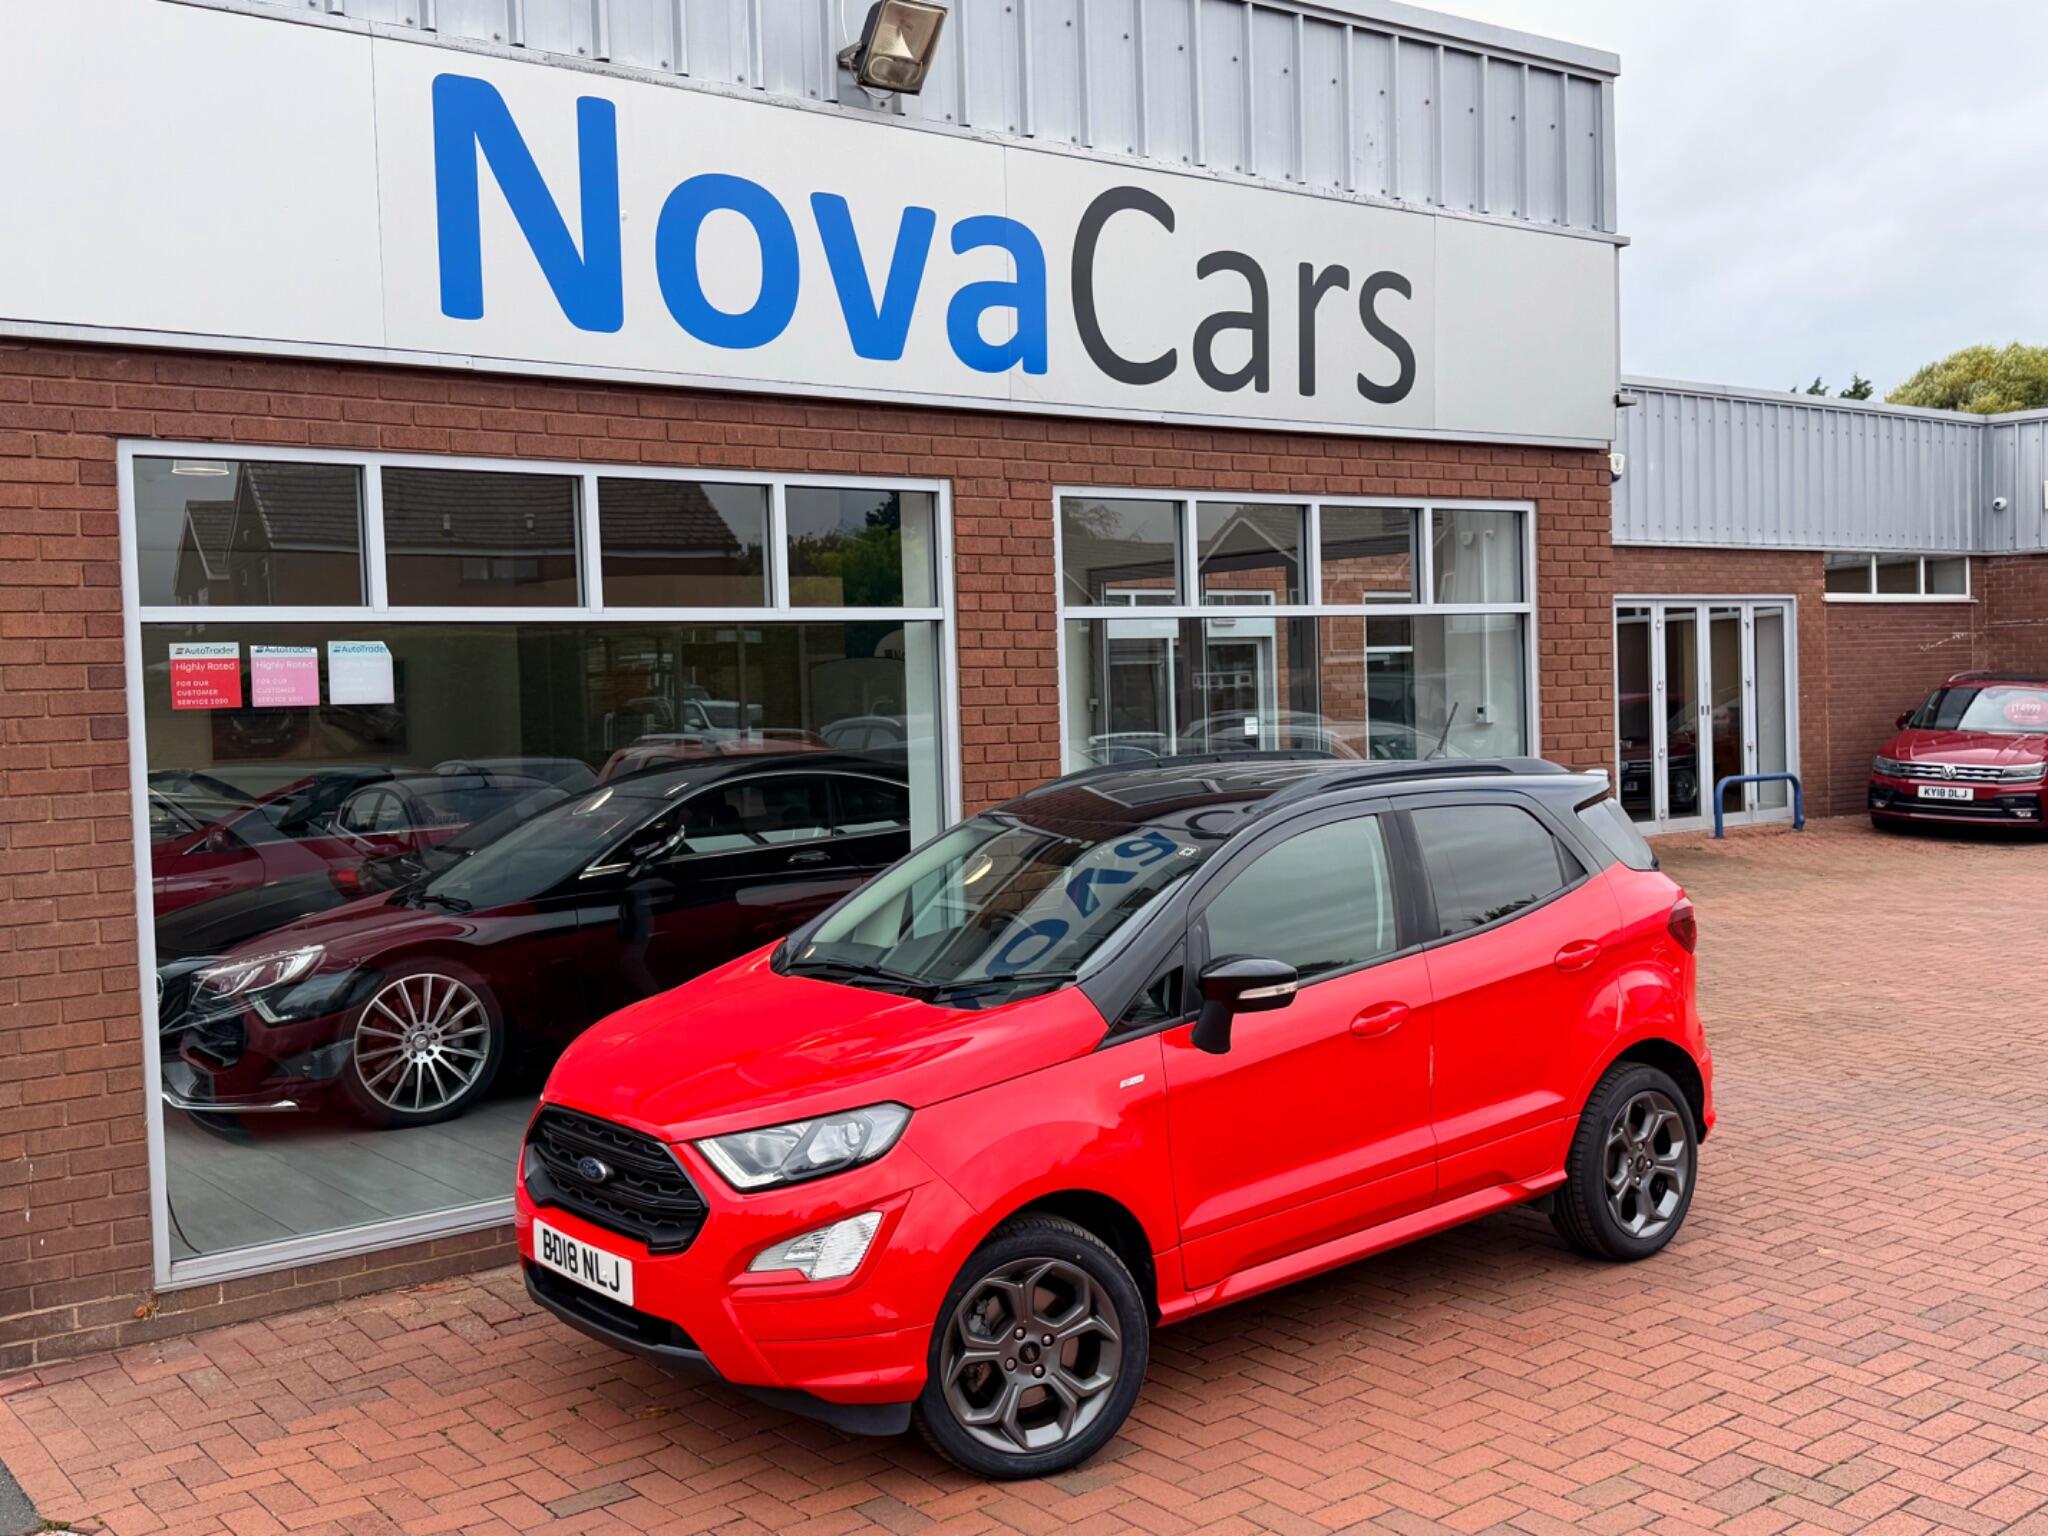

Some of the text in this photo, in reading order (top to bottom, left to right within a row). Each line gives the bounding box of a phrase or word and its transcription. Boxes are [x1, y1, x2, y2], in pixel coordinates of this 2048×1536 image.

[432, 73, 1416, 405] NovaCars
[184, 647, 236, 655] AutoTrader
[175, 662, 236, 673] Highly Rated
[256, 660, 285, 671] Highly
[176, 689, 219, 697] CUSTOMER
[177, 698, 209, 706] SERVICE
[1924, 787, 1968, 798] KY18 DLJ
[543, 1228, 620, 1293] BD18 NLJ
